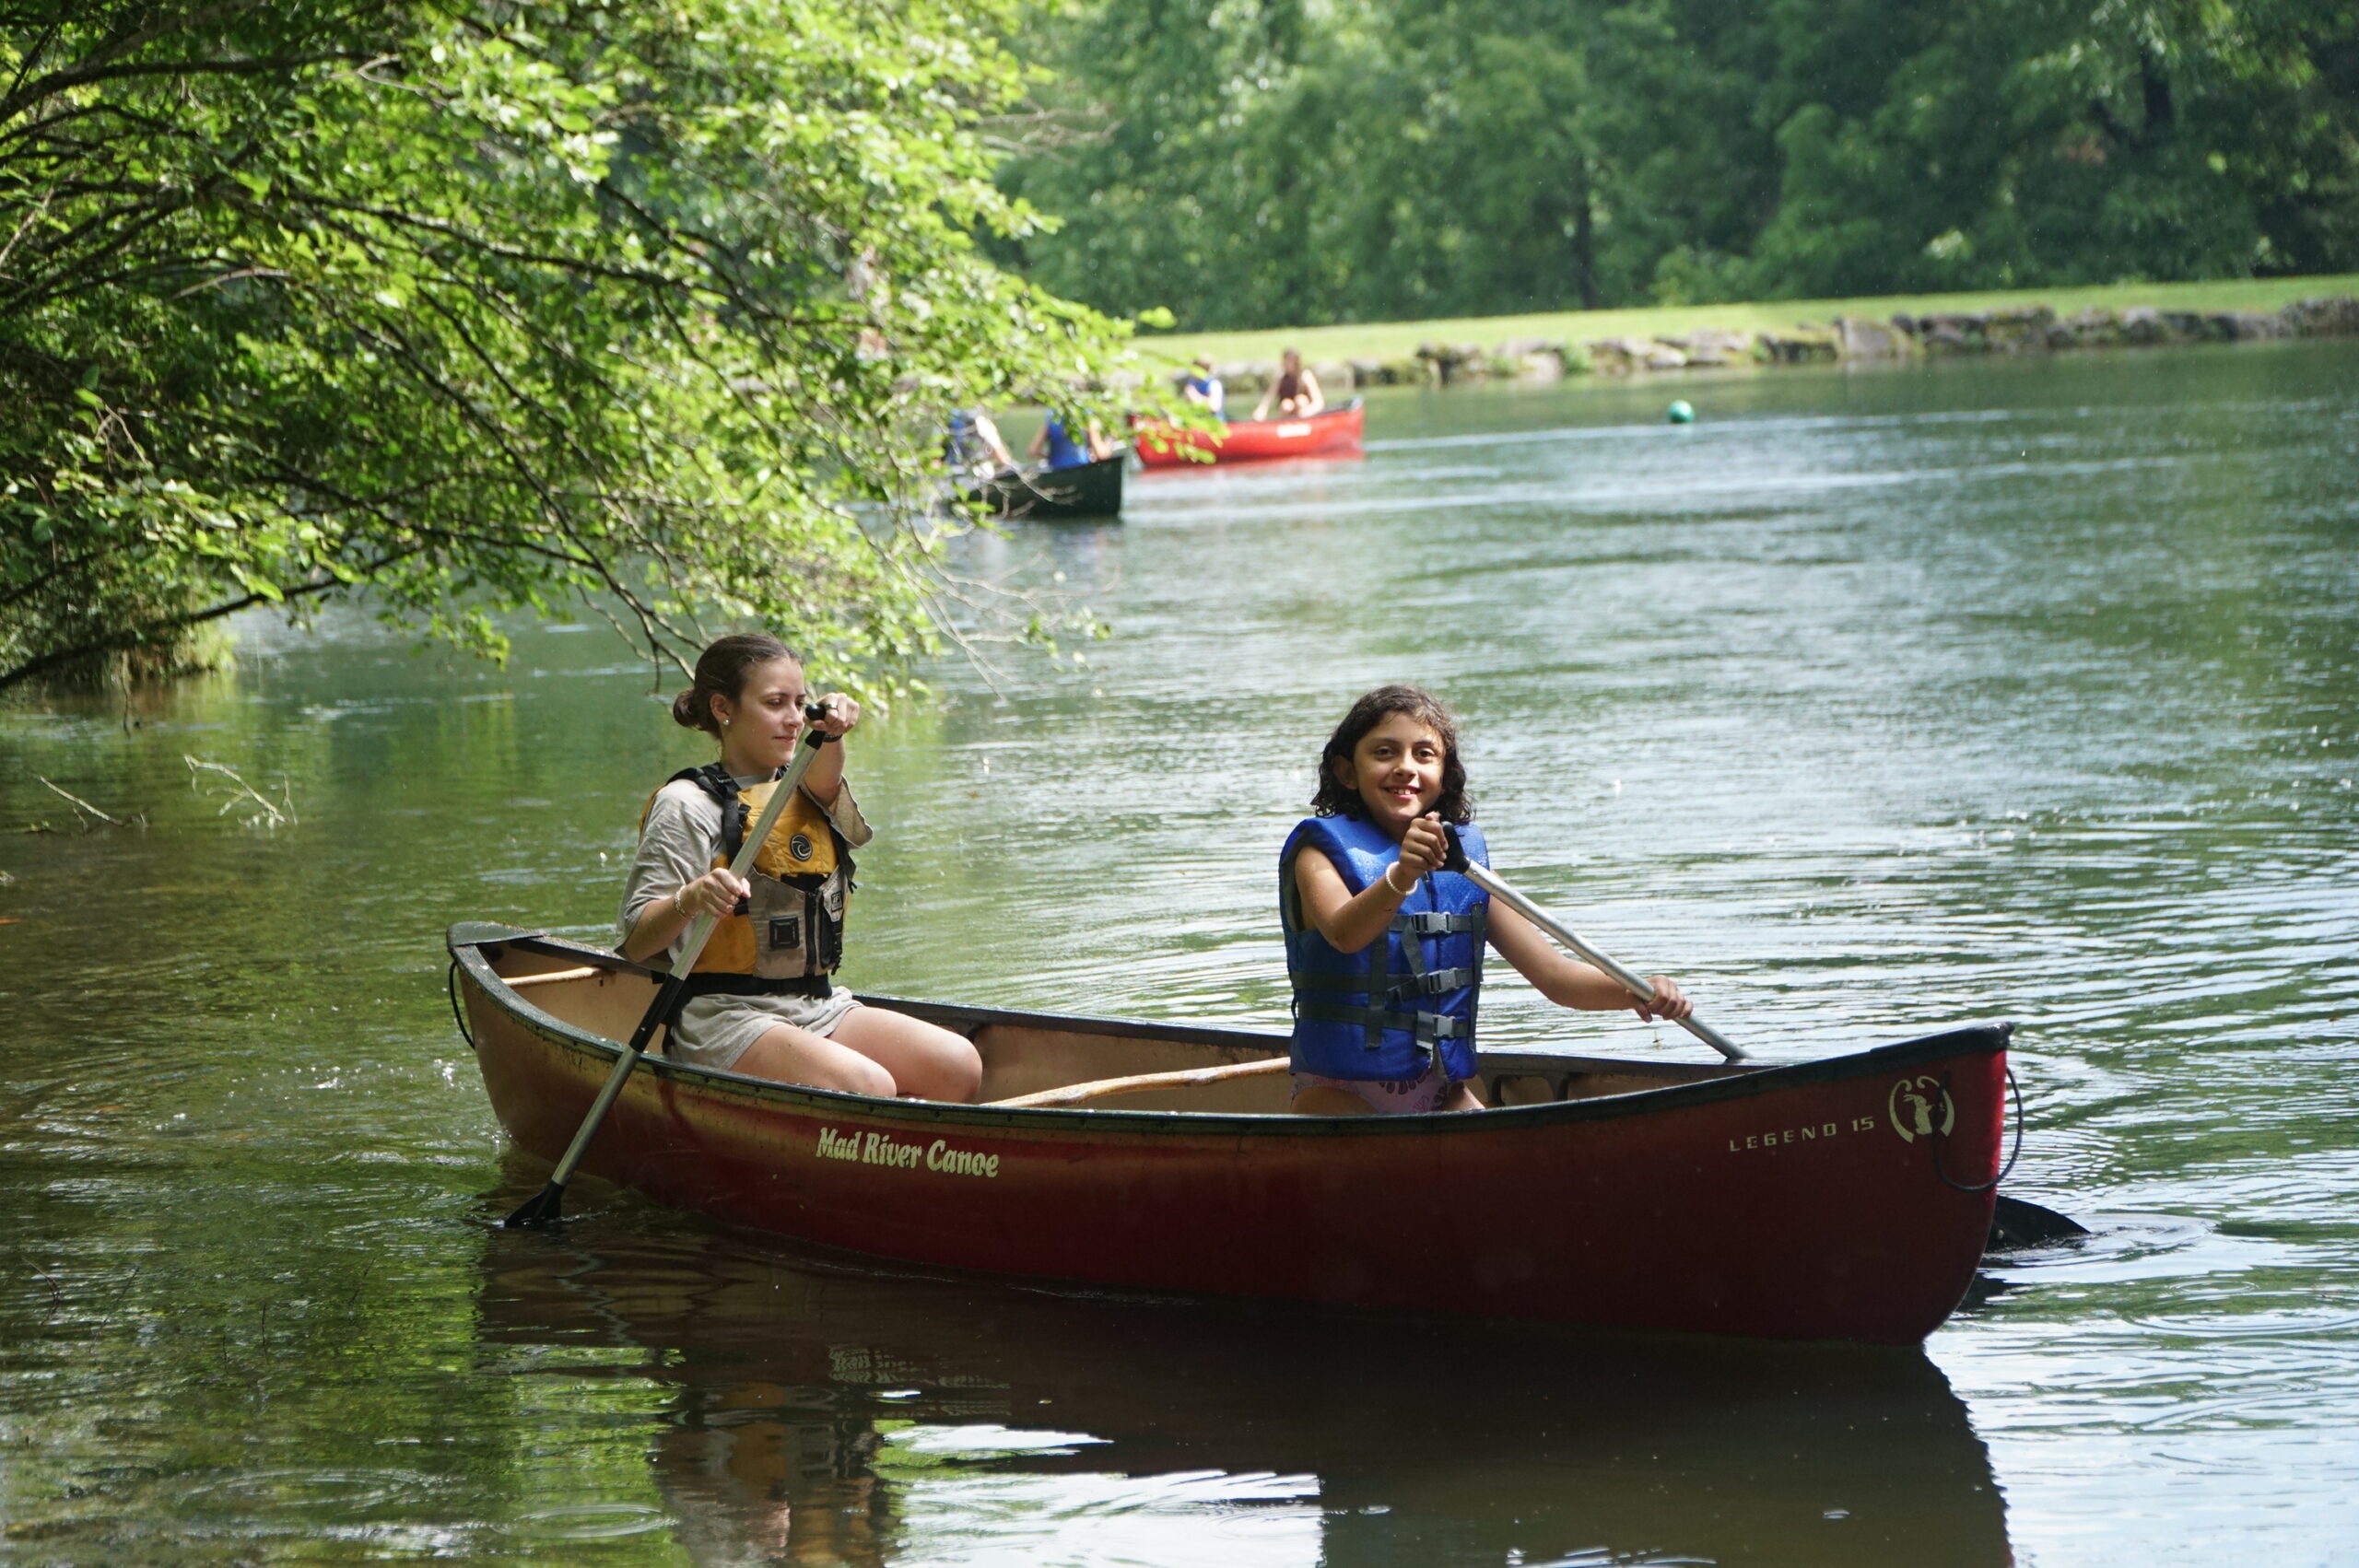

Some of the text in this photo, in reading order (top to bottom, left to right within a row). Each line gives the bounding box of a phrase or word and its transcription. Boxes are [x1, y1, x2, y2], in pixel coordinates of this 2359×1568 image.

[816, 1128, 999, 1177] Mad River Canoe
[1730, 1117, 1874, 1152] LEGEND 15
